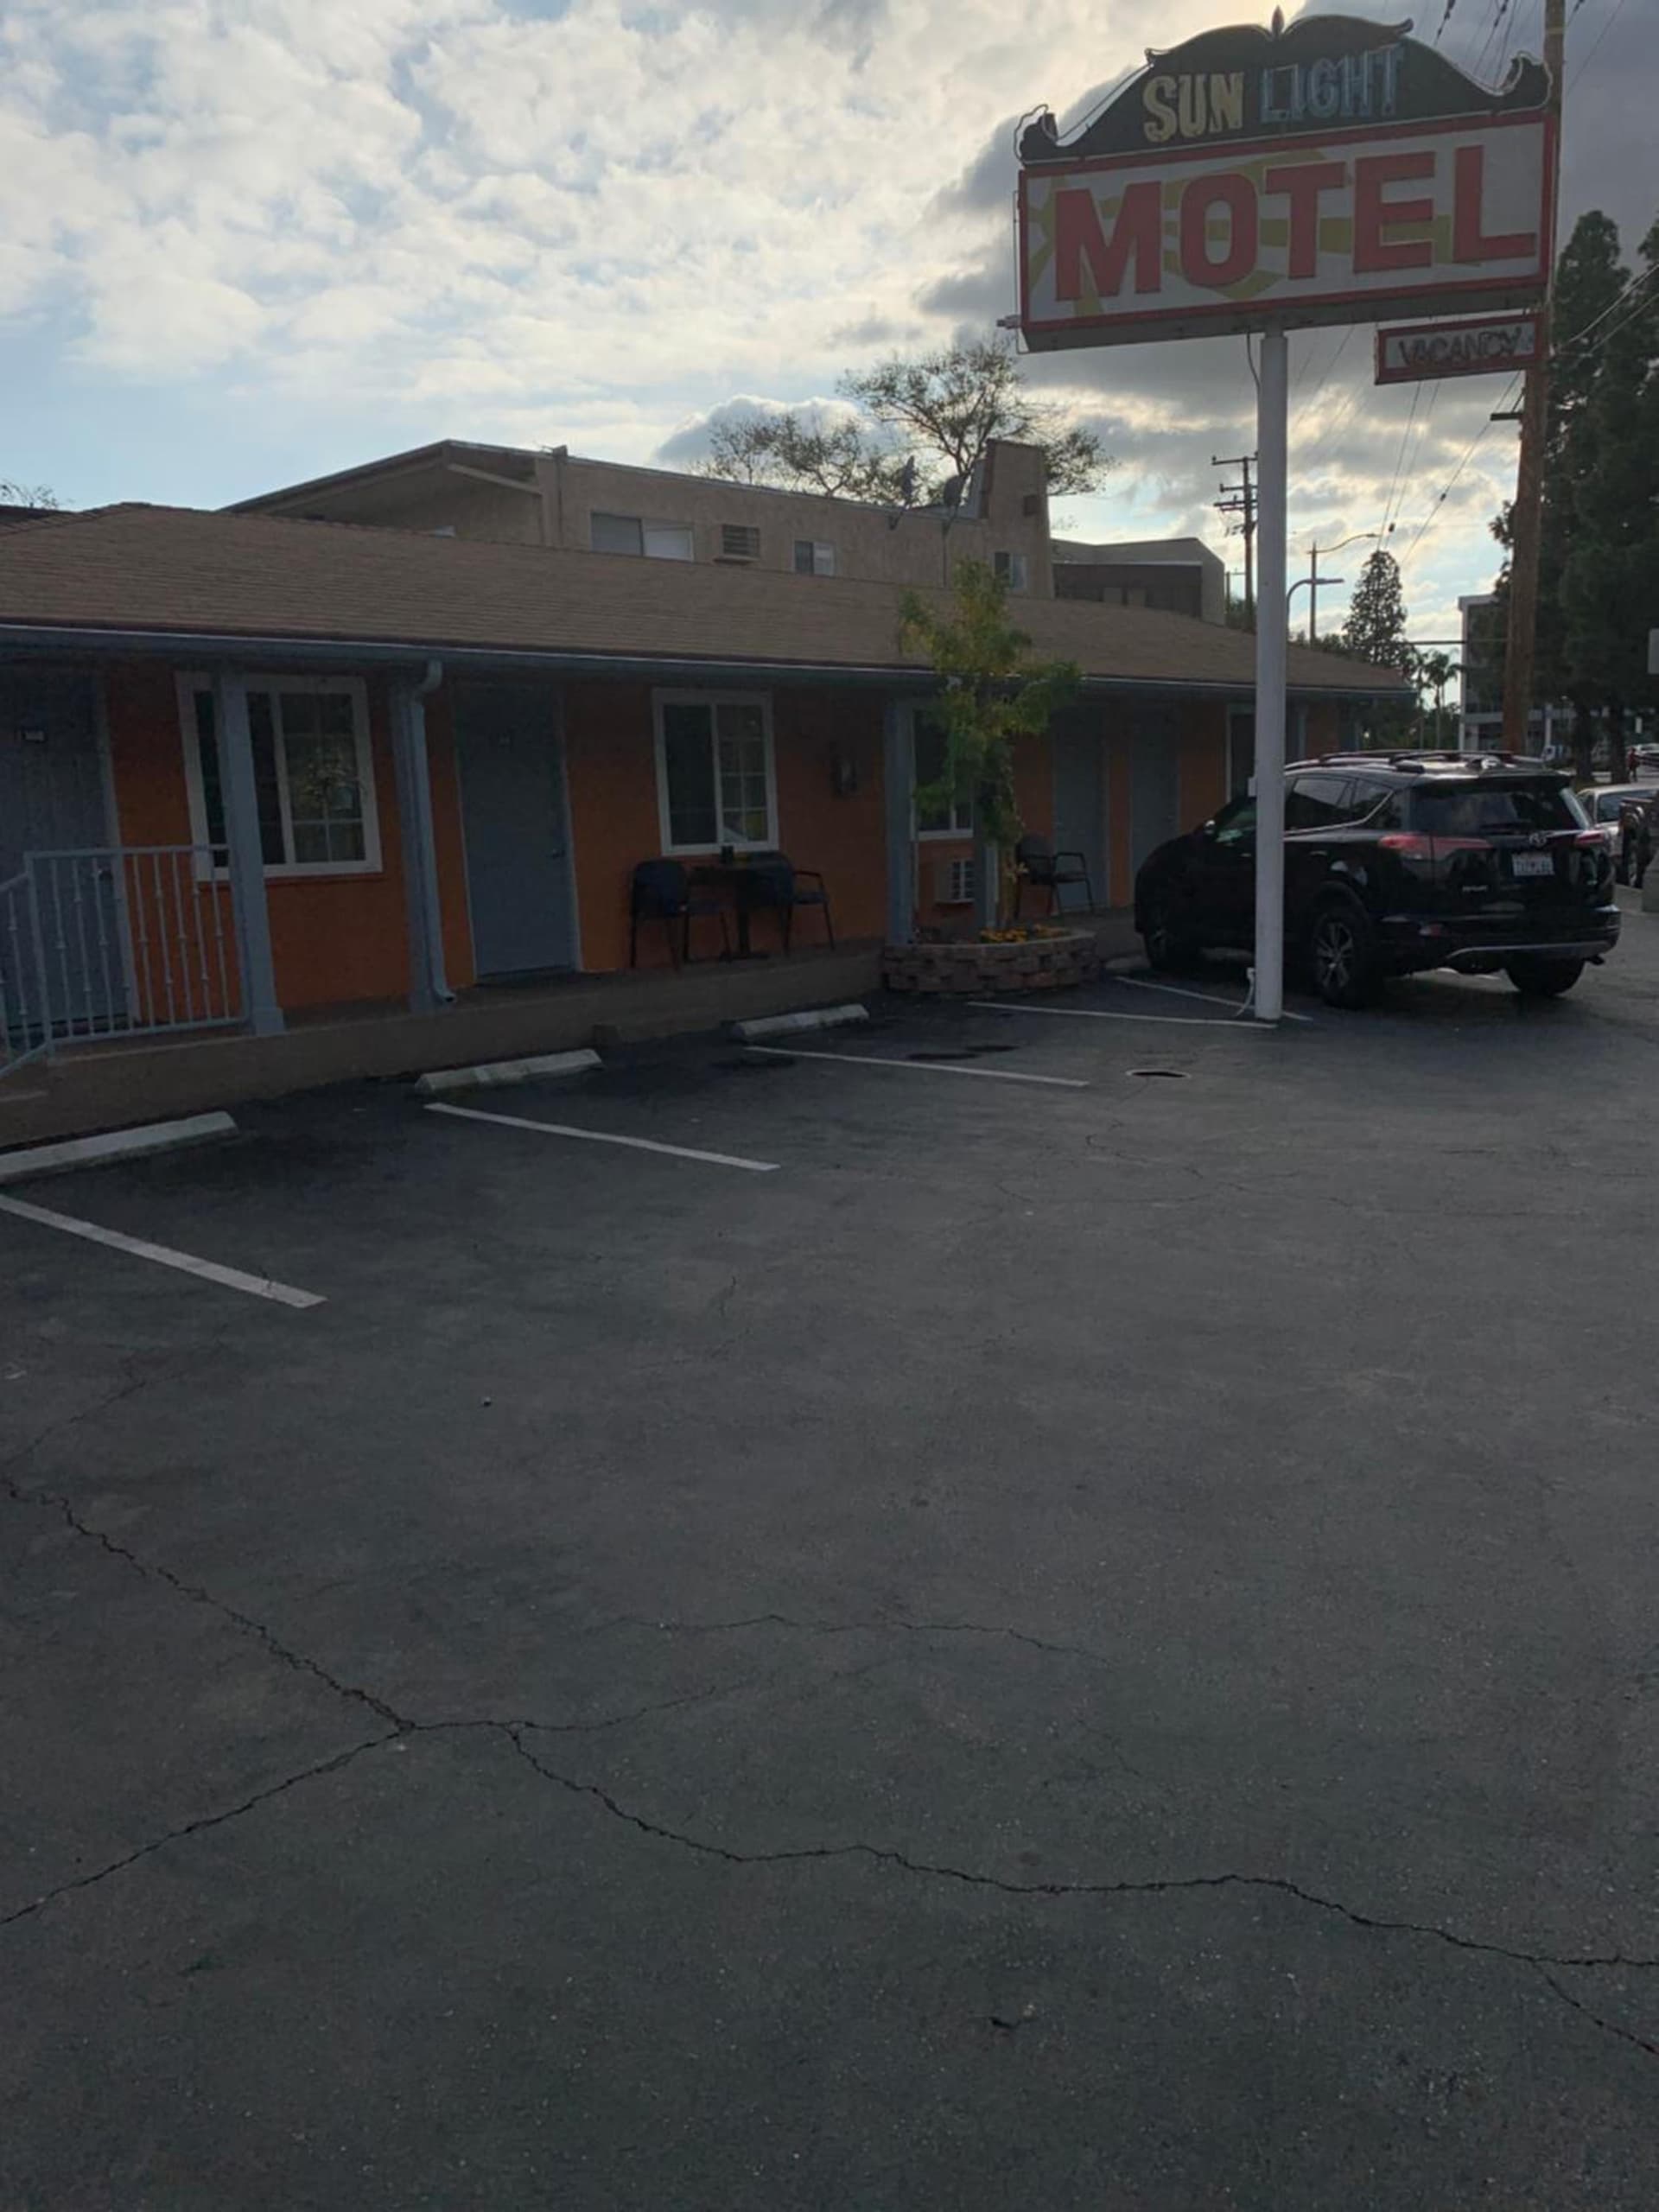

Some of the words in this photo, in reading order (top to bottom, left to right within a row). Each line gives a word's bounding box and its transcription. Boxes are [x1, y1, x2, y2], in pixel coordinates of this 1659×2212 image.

[1142, 73, 1243, 143] SUN
[1260, 44, 1404, 123] LIGHT
[1056, 145, 1536, 302] MOTEL
[1399, 326, 1522, 365] VACANCY
